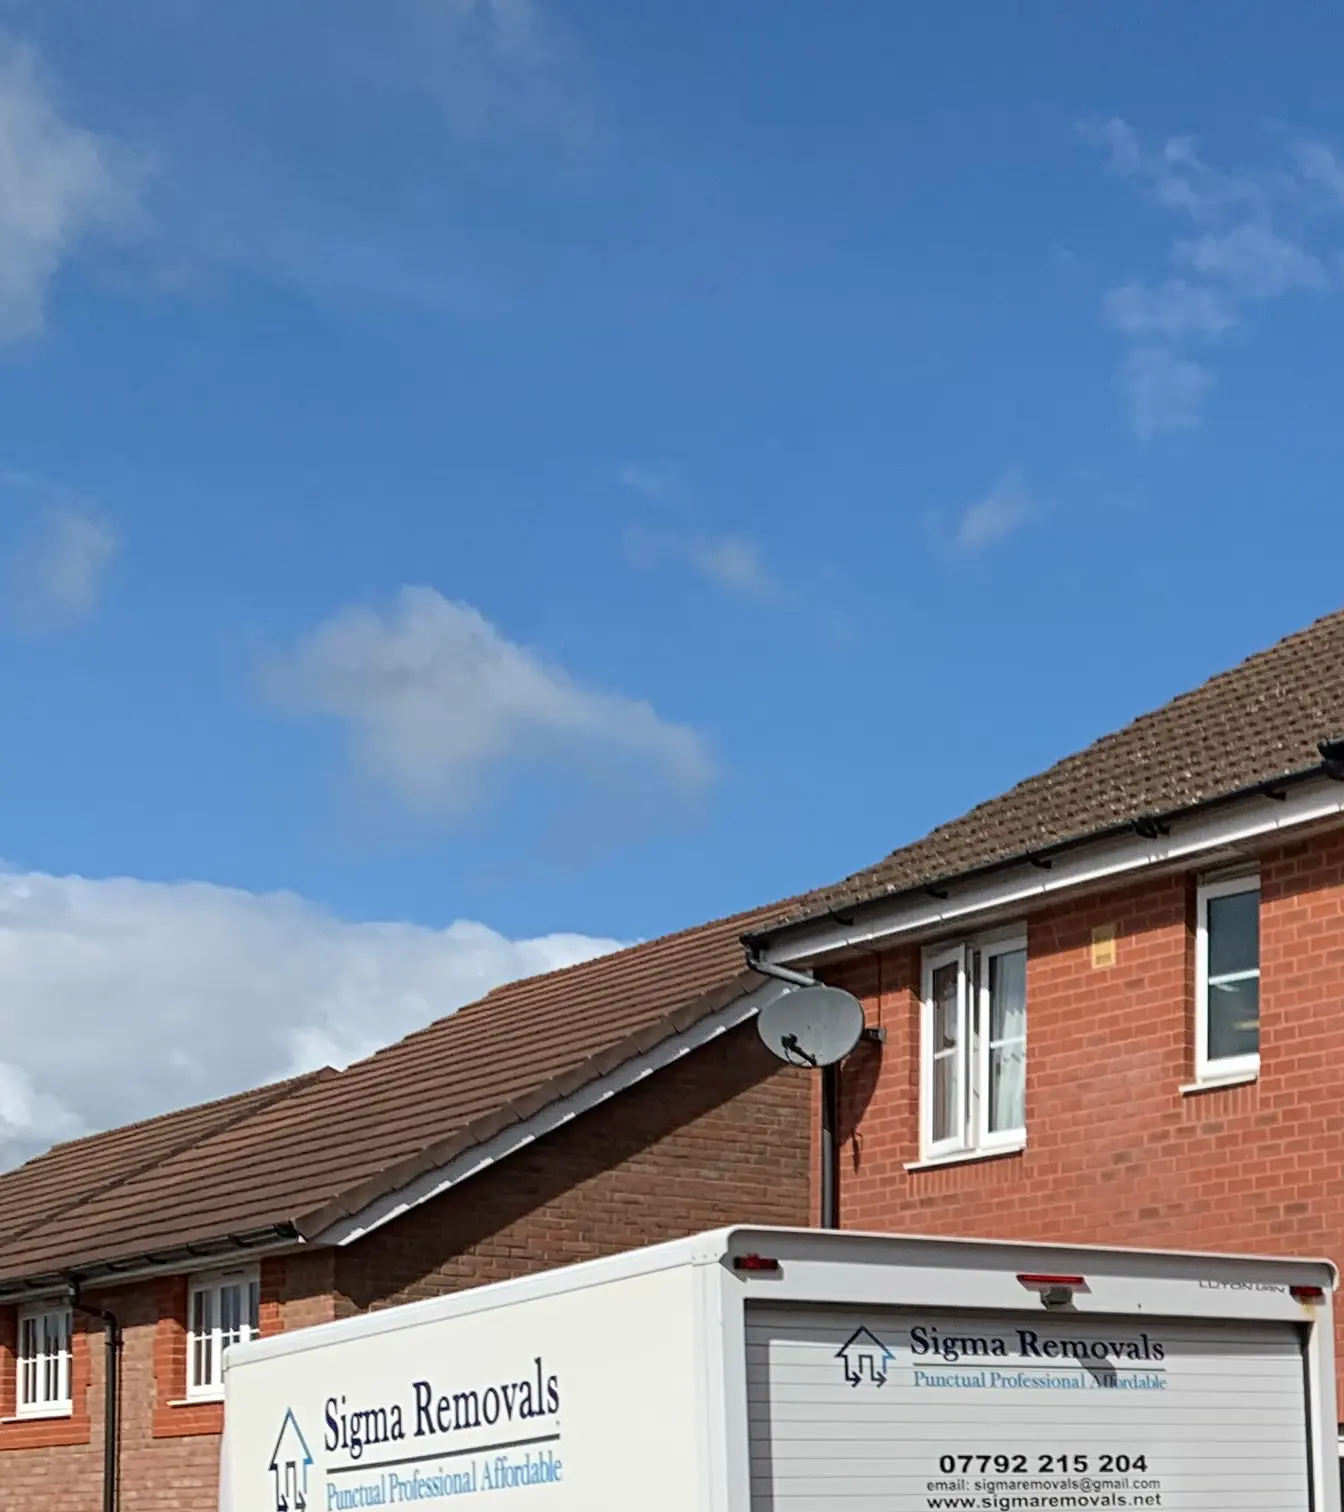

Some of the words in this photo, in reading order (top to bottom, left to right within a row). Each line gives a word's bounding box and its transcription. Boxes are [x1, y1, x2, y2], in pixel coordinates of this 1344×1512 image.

[910, 1326, 1009, 1362] Sigma
[1015, 1329, 1166, 1361] Removals
[913, 1370, 986, 1389] Punctual
[990, 1371, 1086, 1390] Professional
[1090, 1373, 1168, 1391] Affordable
[324, 1396, 405, 1460] Sigma
[412, 1356, 560, 1437] Removals
[939, 1455, 1028, 1474] 07792
[1038, 1454, 1088, 1473] 215
[1098, 1454, 1148, 1473] 204
[327, 1474, 385, 1512] Punctual
[389, 1460, 477, 1503] Professional
[481, 1449, 562, 1491] Affordable
[927, 1479, 970, 1492] email:
[974, 1477, 1161, 1494] sigmaremovals@gmail.com
[927, 1493, 1162, 1511] www.sigmaremovals.net
